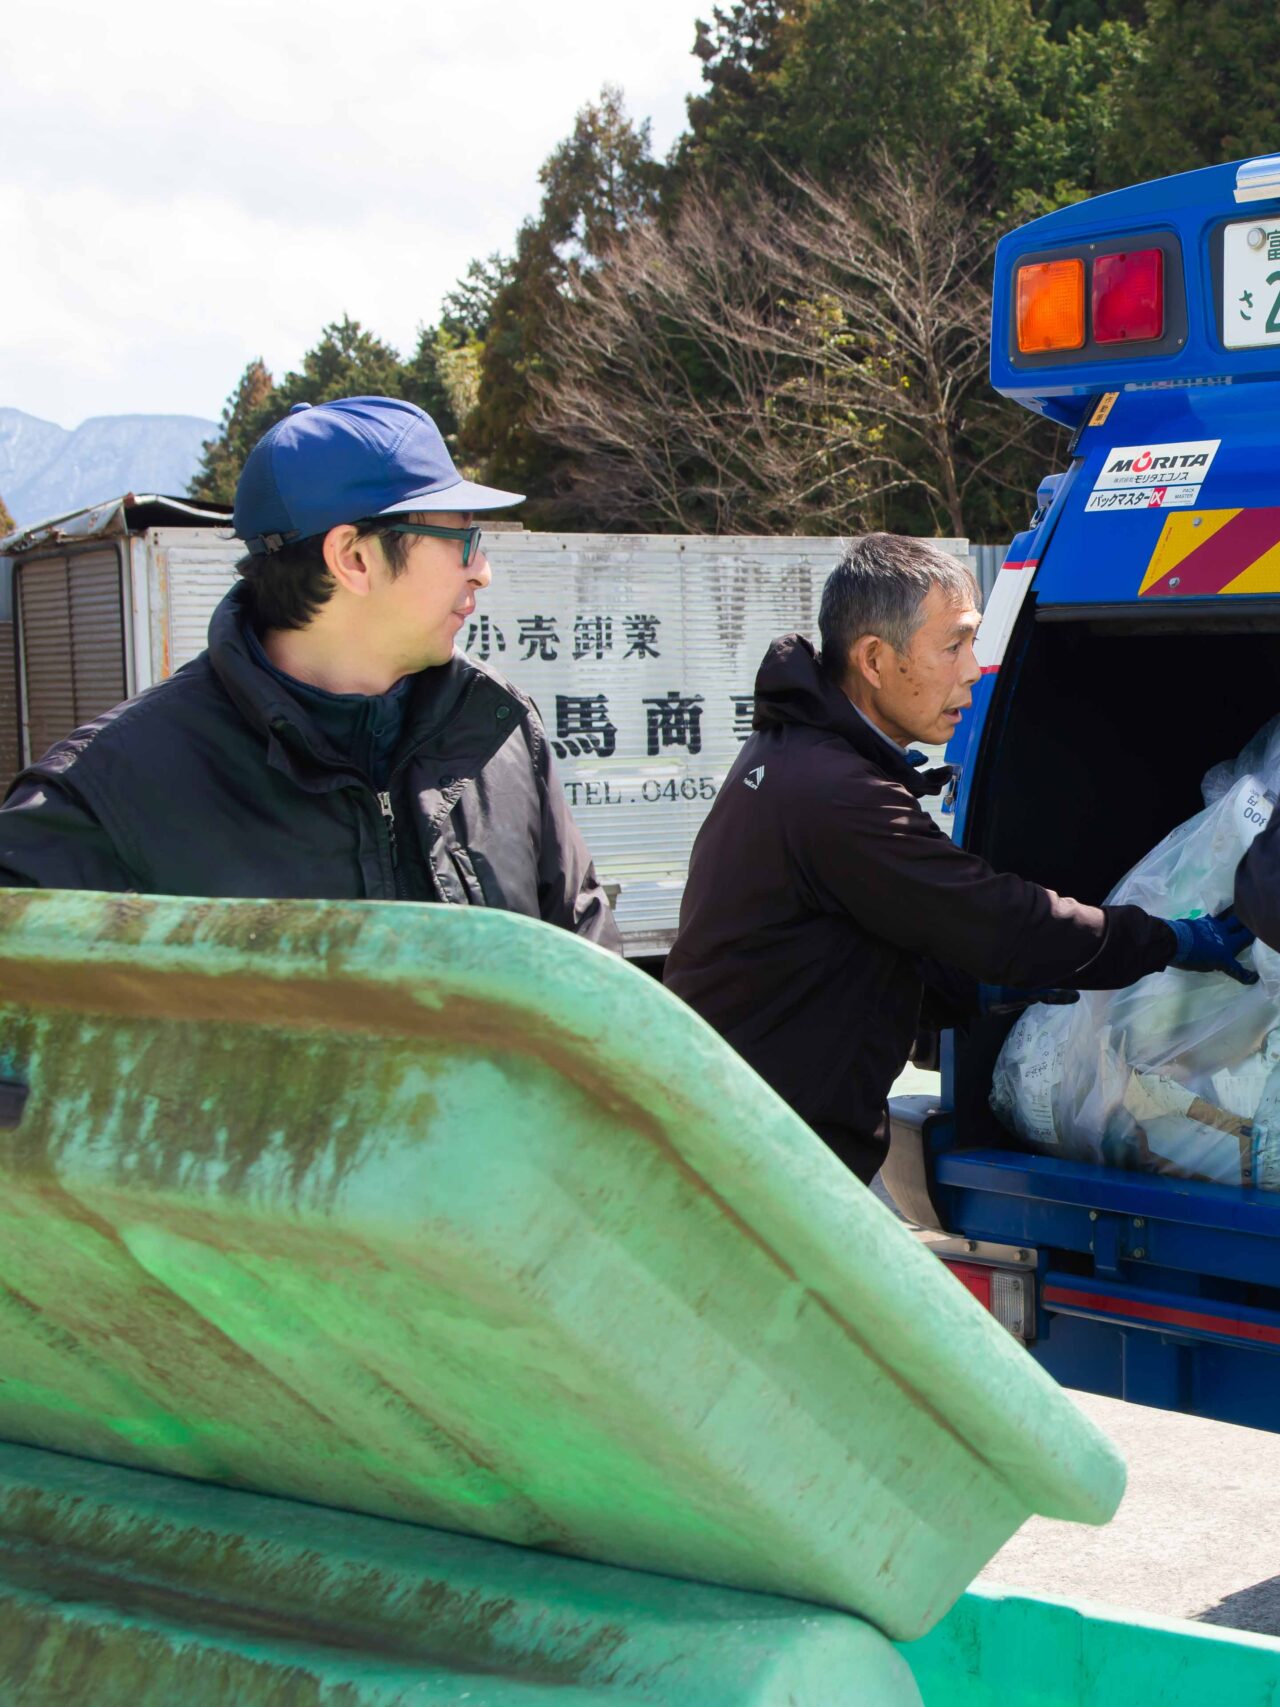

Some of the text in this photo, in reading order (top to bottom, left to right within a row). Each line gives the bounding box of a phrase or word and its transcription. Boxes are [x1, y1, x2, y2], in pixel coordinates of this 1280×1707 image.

[1238, 289, 1254, 321] さ
[1107, 451, 1209, 473] MORITA
[465, 614, 661, 661] 小売卸業
